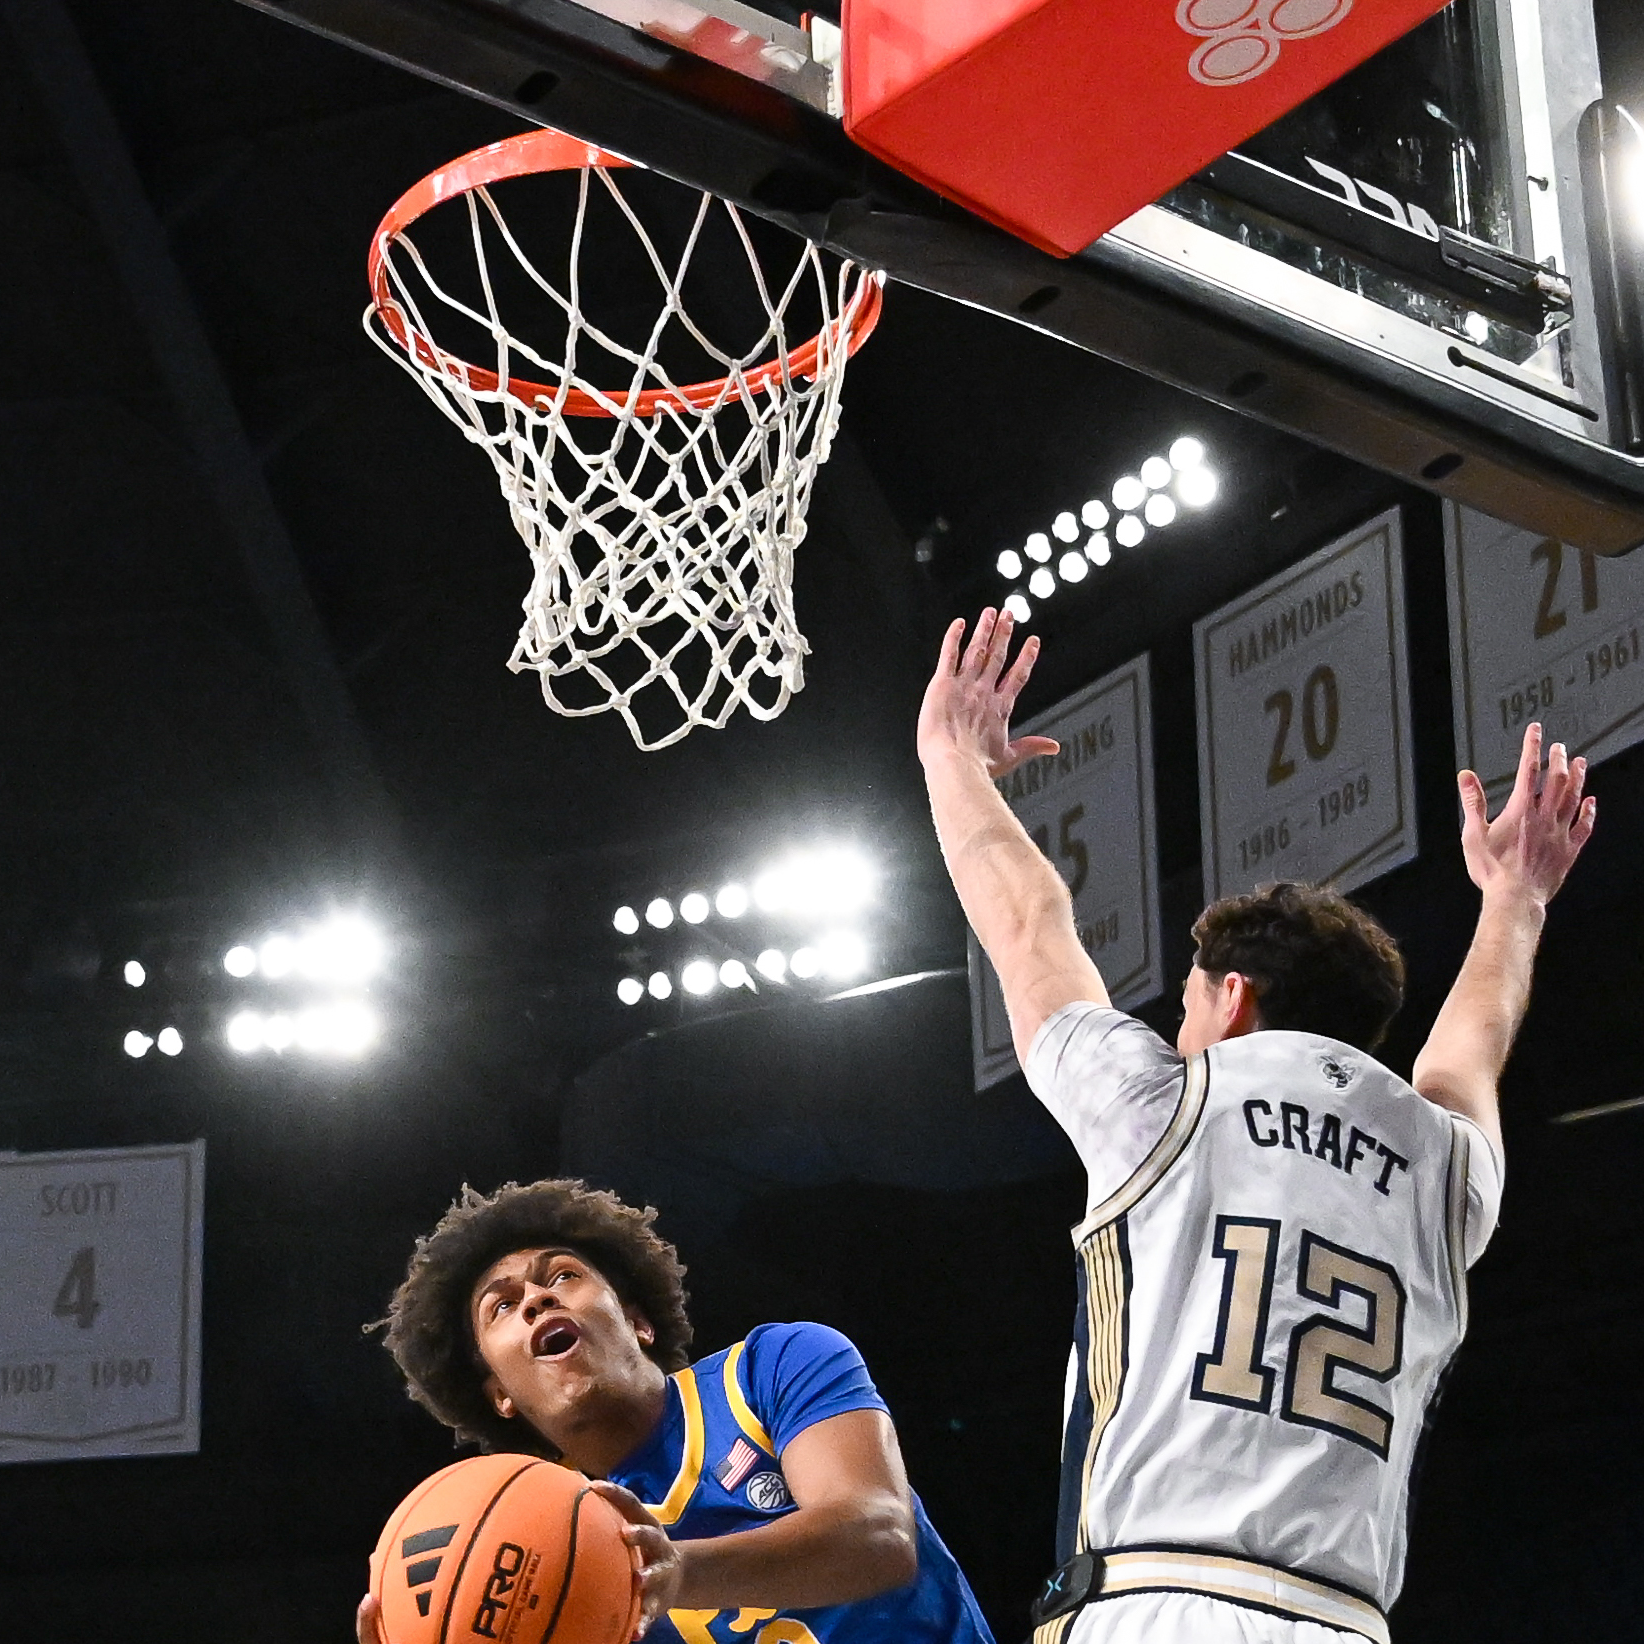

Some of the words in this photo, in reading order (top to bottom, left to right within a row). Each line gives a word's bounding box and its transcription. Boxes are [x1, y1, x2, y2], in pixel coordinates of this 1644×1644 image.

[1229, 570, 1367, 678] HAMMONDS
[1263, 663, 1340, 789] 20
[1242, 1098, 1410, 1197] CRAFT
[39, 1181, 120, 1217] SCOTT
[53, 1246, 101, 1330] 4
[1189, 1213, 1408, 1463] 12
[471, 1541, 525, 1639] PRO
